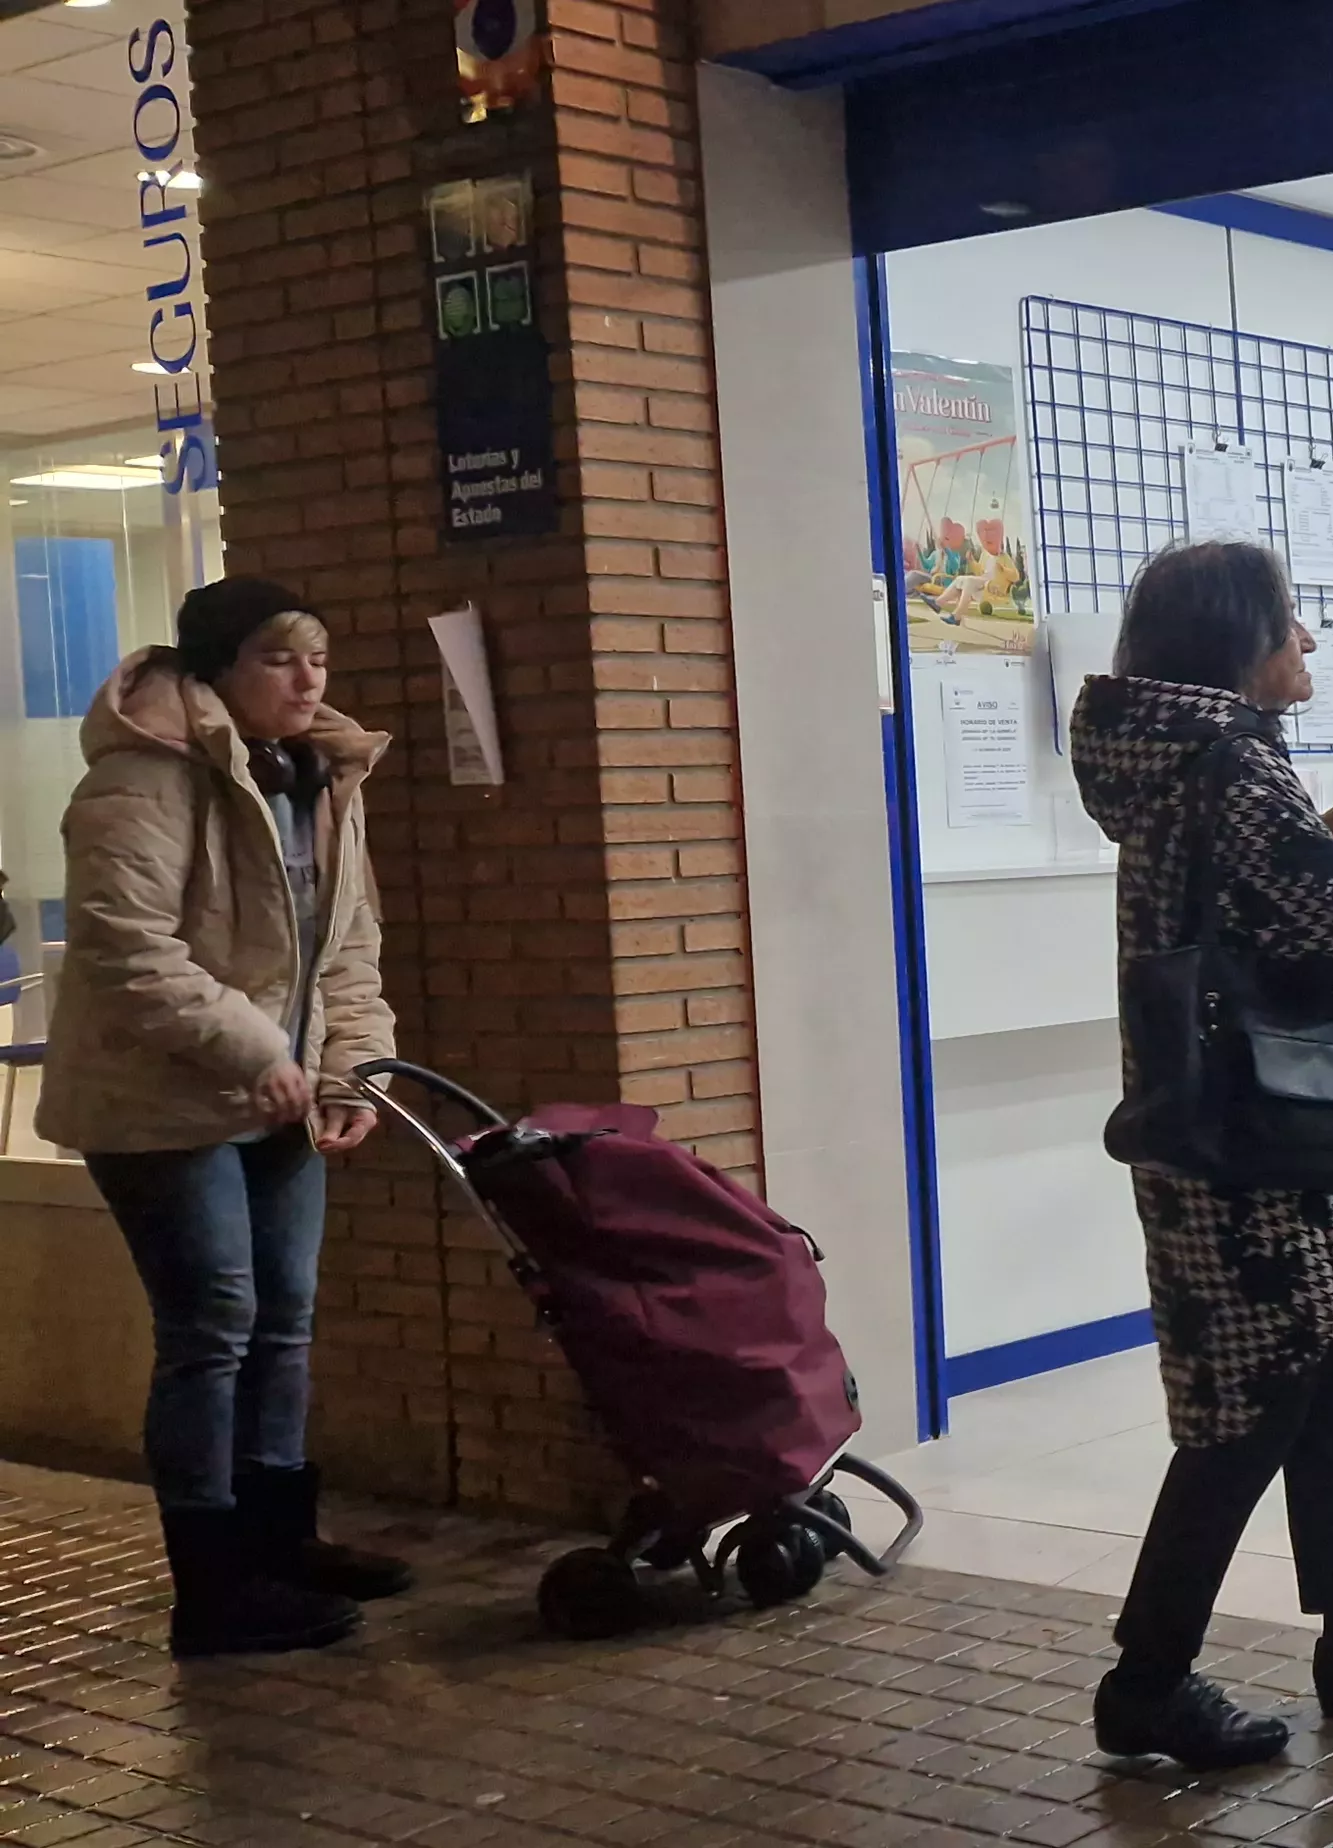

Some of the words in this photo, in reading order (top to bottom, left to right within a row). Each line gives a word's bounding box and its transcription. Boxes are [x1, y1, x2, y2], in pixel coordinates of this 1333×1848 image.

[128, 18, 206, 498] SEGUROS
[905, 384, 993, 423] Valentín
[450, 475, 518, 503] Apuestas
[520, 468, 543, 490] del
[452, 504, 503, 528] Estado
